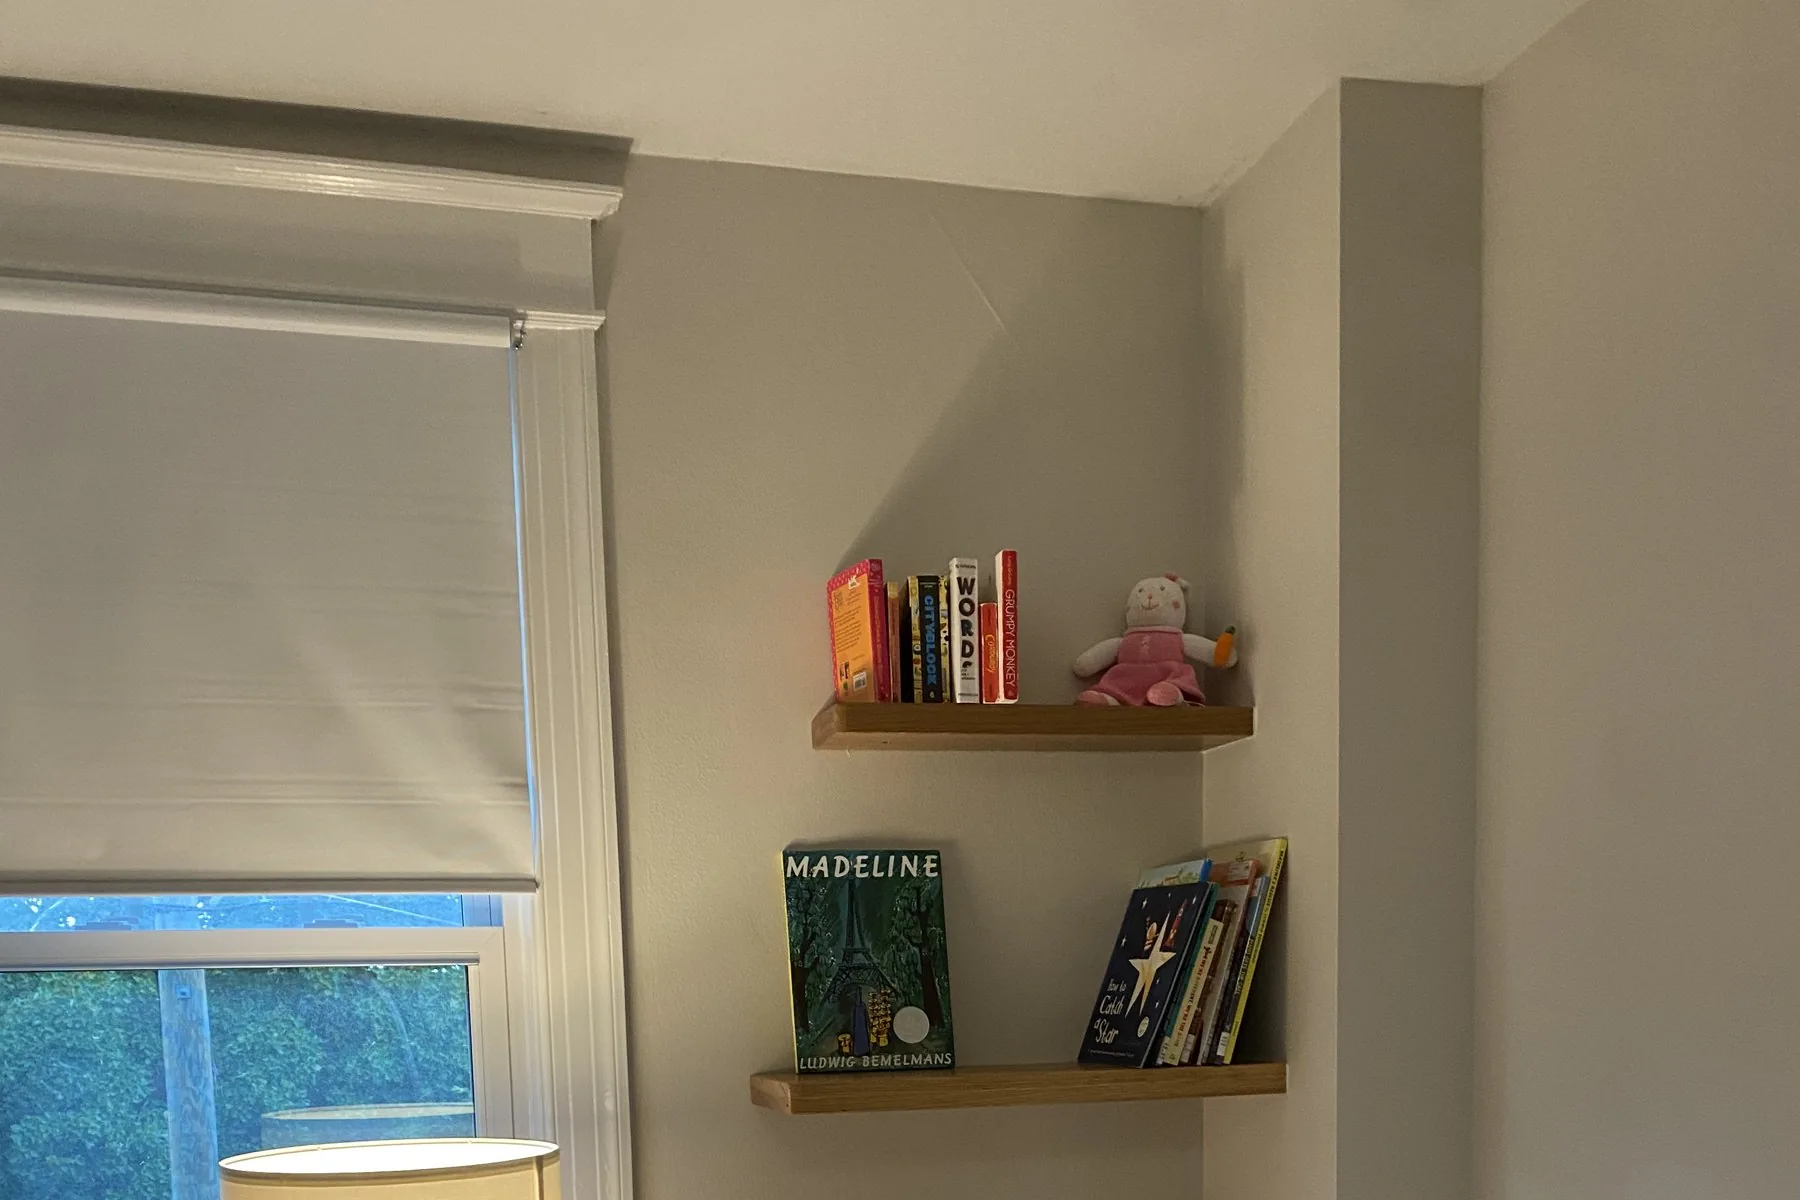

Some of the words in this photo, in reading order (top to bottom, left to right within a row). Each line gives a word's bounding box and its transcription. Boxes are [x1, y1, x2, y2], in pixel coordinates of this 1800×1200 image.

[1005, 589, 1015, 638] GRUMPY
[924, 595, 936, 685] CITYBLOCK
[1005, 640, 1016, 688] MONKEY
[786, 854, 939, 878] MADELINE
[1119, 980, 1127, 992] to
[1099, 995, 1126, 1016] Catch
[1094, 1018, 1102, 1029] a
[1095, 1018, 1119, 1045] Star
[799, 1055, 857, 1070] LUDWIG
[862, 1052, 952, 1068] BEMELMANS
